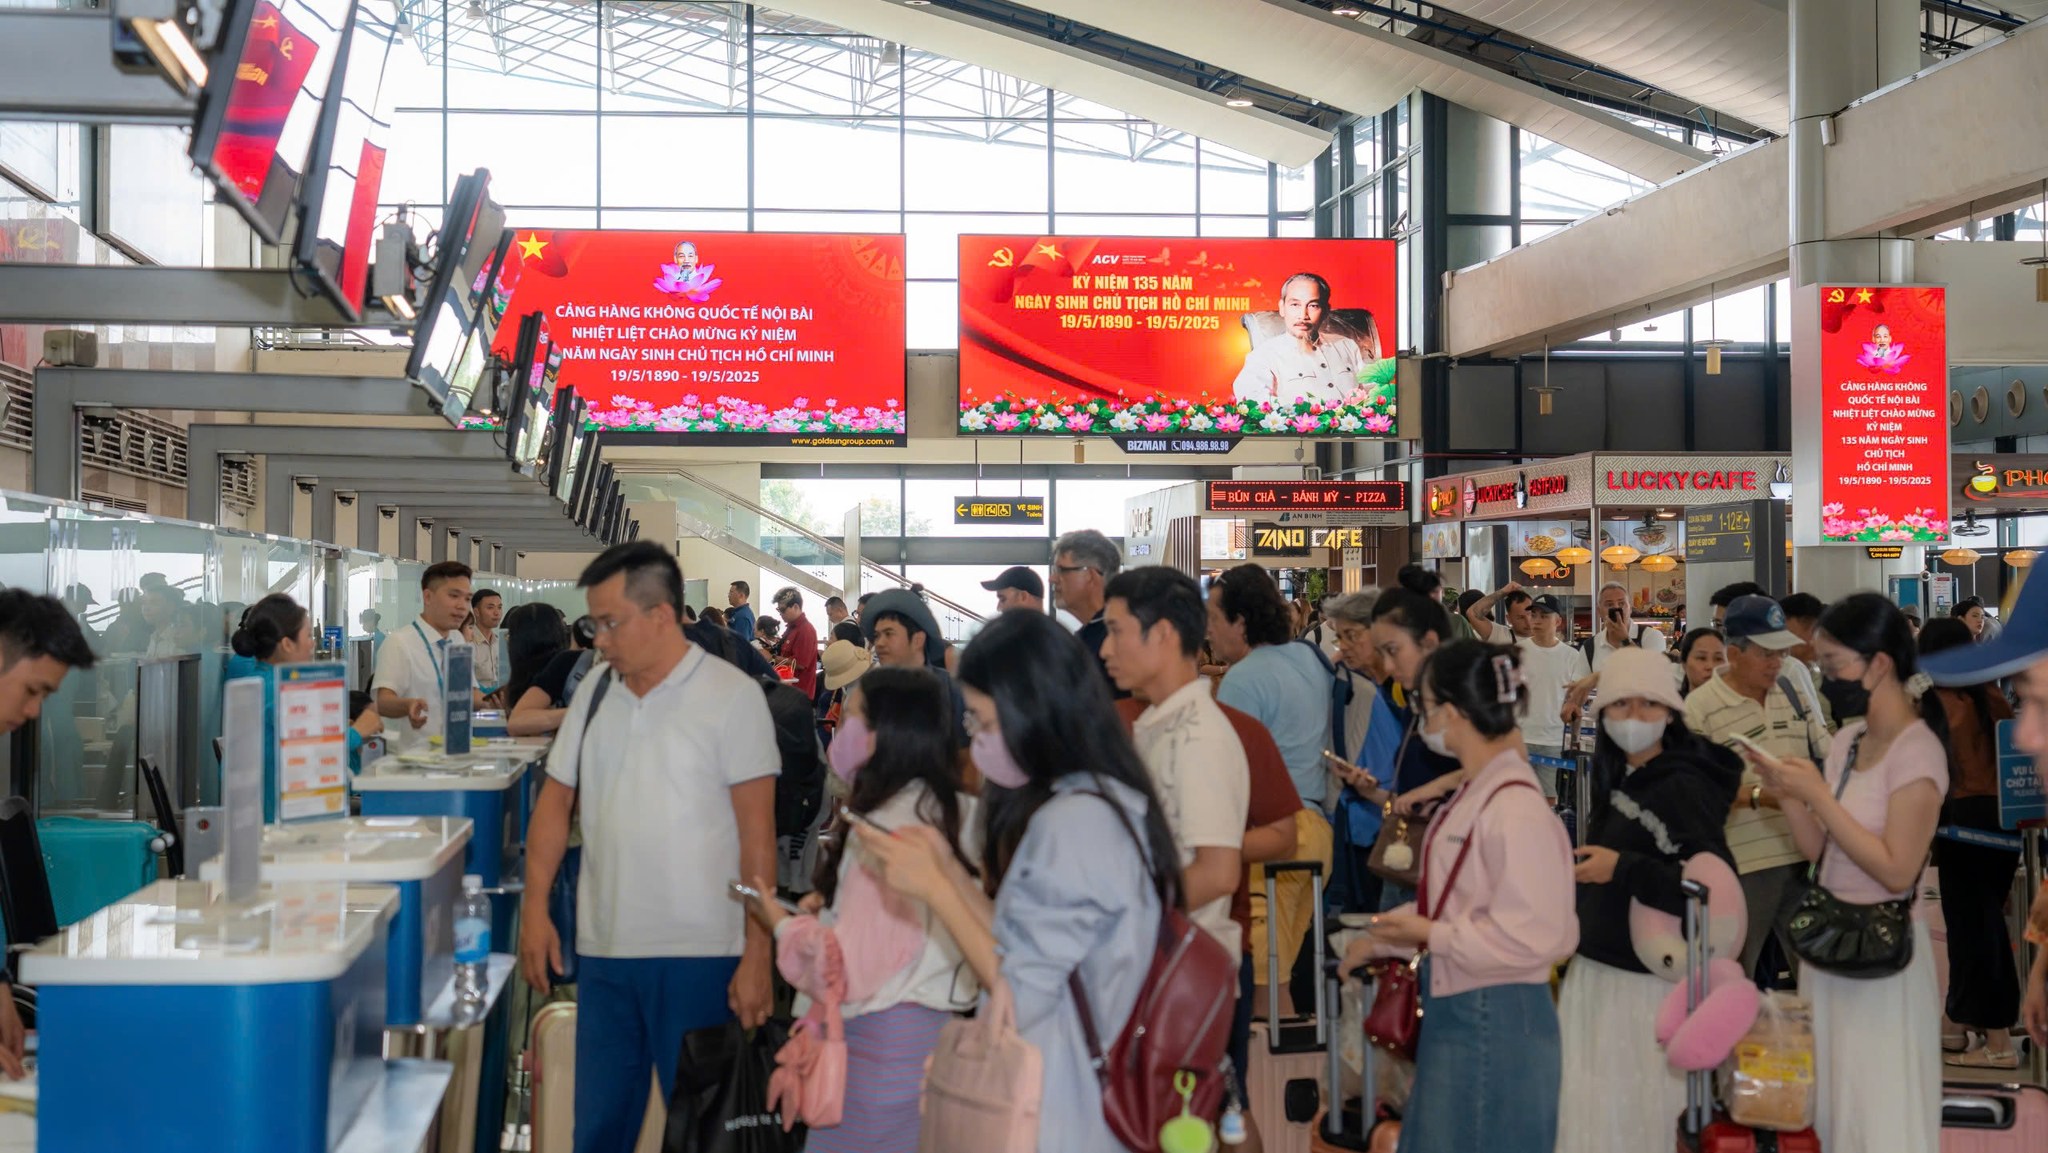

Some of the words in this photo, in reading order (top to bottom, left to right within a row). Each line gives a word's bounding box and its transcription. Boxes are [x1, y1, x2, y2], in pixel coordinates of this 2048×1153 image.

[1092, 255, 1119, 264] ACV
[1095, 274, 1129, 292] NIỆM
[1133, 276, 1158, 290] 135
[1162, 274, 1193, 290] NĂM
[1015, 294, 1051, 309] NGÀY
[1055, 296, 1089, 309] SINH
[1093, 293, 1121, 310] CHỦ
[1126, 296, 1158, 312] TỊCH
[1162, 292, 1181, 310] HỒ
[1185, 295, 1210, 311] CHÍ
[1214, 297, 1250, 311] MINH
[555, 302, 596, 318] CẢNG
[599, 304, 640, 319] HÀNG
[643, 304, 695, 319] KHÔNG
[698, 304, 740, 321] QUỐC
[742, 304, 759, 320] TẾ
[761, 306, 787, 323] NỘI
[790, 306, 813, 321] BÀI
[1060, 315, 1133, 329] 19/5/1890
[1146, 315, 1220, 330] 19/5/2025
[572, 324, 615, 342] NHIỆT
[617, 325, 646, 342] LIỆT
[649, 326, 689, 340] CHÀO
[692, 325, 737, 341] MỪNG
[740, 326, 758, 341] KỶ
[761, 327, 797, 344] NIỆM
[562, 345, 596, 360] NĂM
[599, 346, 638, 361] NGÀY
[641, 349, 675, 361] SINH
[677, 345, 708, 361] CHỦ
[710, 349, 742, 365] TỊCH
[745, 347, 767, 362] HỒ
[769, 348, 794, 362] CHÍ
[796, 350, 834, 362] MINH
[610, 370, 679, 382] 19/5/1890
[691, 371, 760, 383] 19/5/2025
[1841, 381, 1866, 391] CẢNG
[1868, 382, 1893, 391] HÀNG
[1895, 382, 1927, 391] KHÔNG
[1887, 396, 1903, 406] NỘI
[1905, 396, 1920, 404] BÀI
[1833, 408, 1859, 419] NHIỆT
[1861, 408, 1879, 420] LIỆT
[1880, 408, 1905, 418] CHÀO
[1907, 408, 1935, 418] MỪNG
[1880, 422, 1902, 432] NIỆM
[791, 437, 894, 446] www.goldsungroup.com.vn
[1127, 441, 1167, 451] BIZMAN
[1841, 436, 1857, 444] 135
[1881, 435, 1905, 444] NGÀY
[1907, 436, 1928, 444] SINH
[1885, 450, 1905, 460] TỊCH
[1872, 462, 1887, 471] CHÍ
[1889, 463, 1912, 471] MINH
[1607, 470, 1690, 490] LUCKY
[1692, 470, 1757, 490] CAFE
[1839, 476, 1881, 485] 19/5/1890
[1889, 476, 1931, 485] 19/5/2025
[2004, 469, 2048, 487] PH
[1530, 475, 1567, 497] FASTFOOD
[1228, 489, 1249, 502] BÚN
[1292, 489, 1319, 502] BÁNH
[1356, 493, 1386, 503] PIZZA
[1719, 511, 1736, 531] 1-12
[1311, 529, 1363, 550] CAFE
